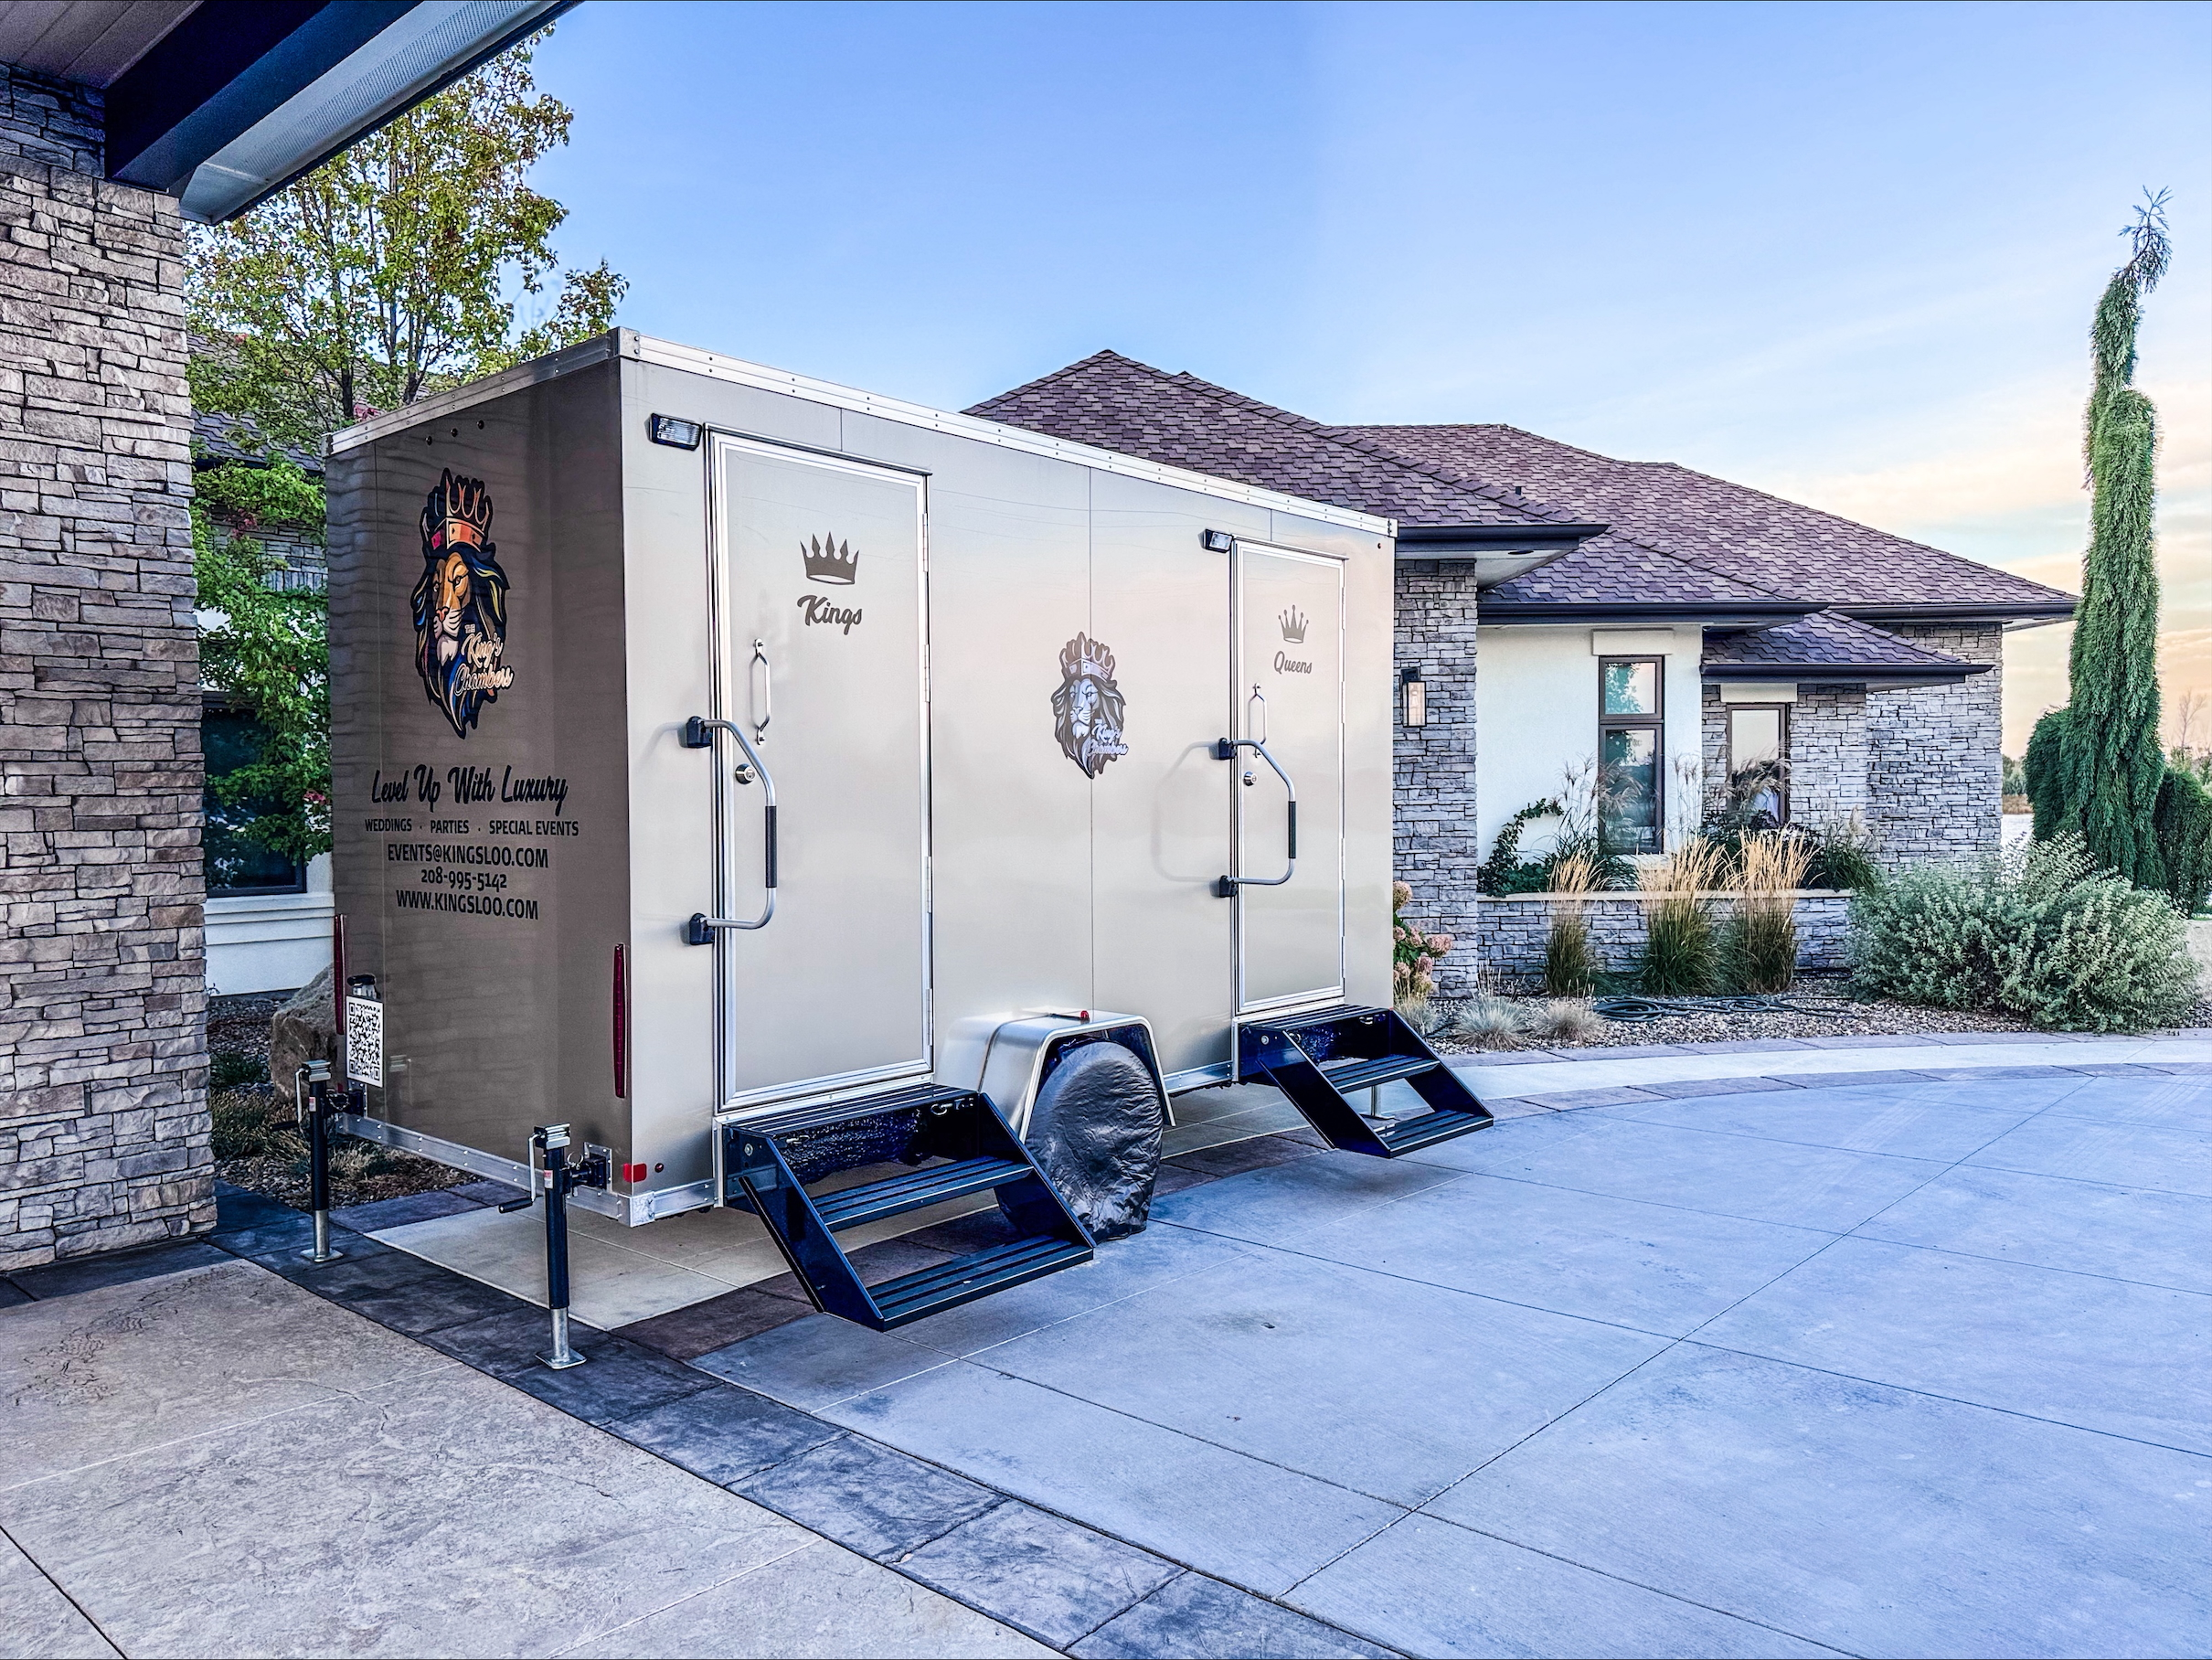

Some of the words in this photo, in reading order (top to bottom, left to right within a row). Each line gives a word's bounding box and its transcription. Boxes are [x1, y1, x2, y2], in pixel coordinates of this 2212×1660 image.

[796, 594, 863, 635] Kings
[461, 632, 504, 668] King's
[1273, 650, 1313, 675] Queens
[454, 663, 514, 696] Chambers
[371, 769, 409, 803] Level
[413, 764, 441, 813] Up
[447, 766, 495, 803] With
[501, 764, 569, 816] Luxury
[365, 818, 412, 832] WEDDINGS
[431, 819, 469, 834] PARTIES
[489, 820, 533, 835] SPECIAL
[536, 821, 580, 836] EVENTS
[388, 843, 548, 868] EVENTS@KINGSLOO.COM
[420, 866, 507, 892] 208-995-5142
[396, 889, 538, 920] WWW.KINGSLOO.COM
